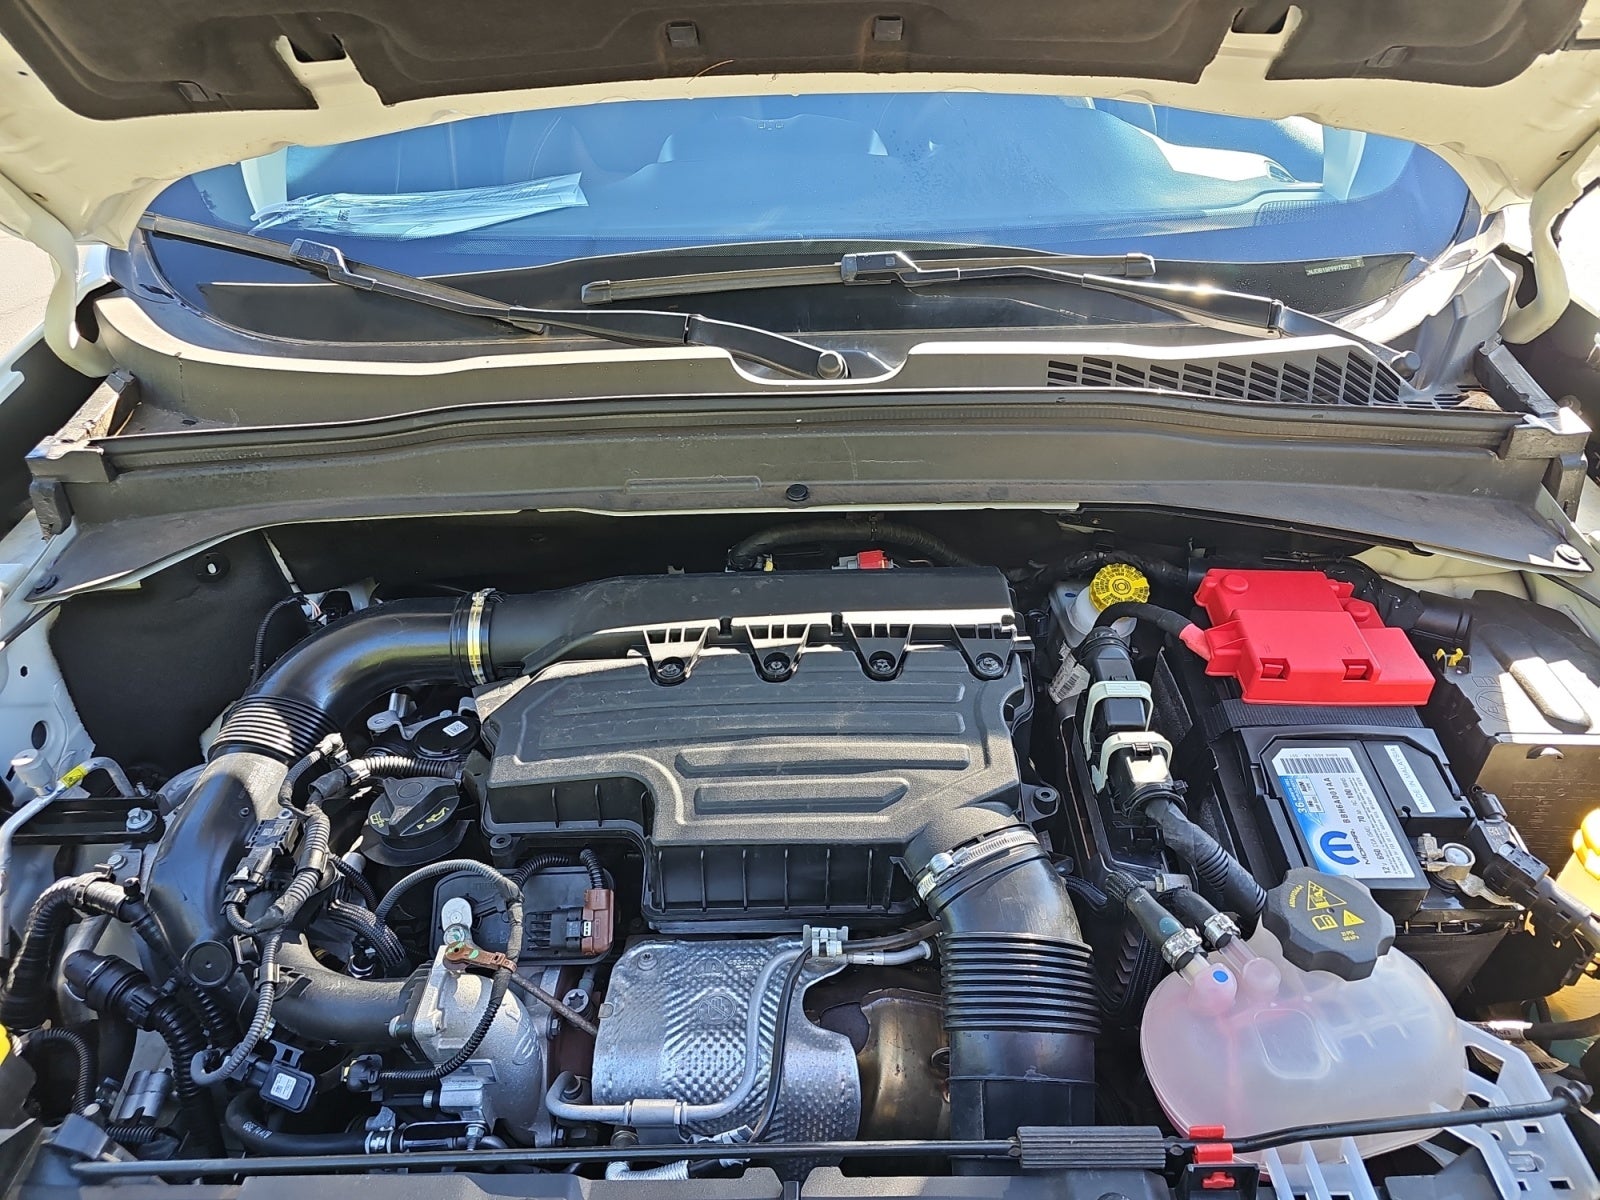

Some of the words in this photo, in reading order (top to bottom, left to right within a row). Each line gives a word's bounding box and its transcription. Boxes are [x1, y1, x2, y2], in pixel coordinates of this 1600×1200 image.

[1390, 747, 1409, 779] MALAYSIA
[1344, 788, 1354, 799] 100
[1413, 790, 1428, 808] MADE
[1295, 801, 1308, 814] 36
[1357, 815, 1366, 823] 70
[1374, 847, 1384, 860] 650
